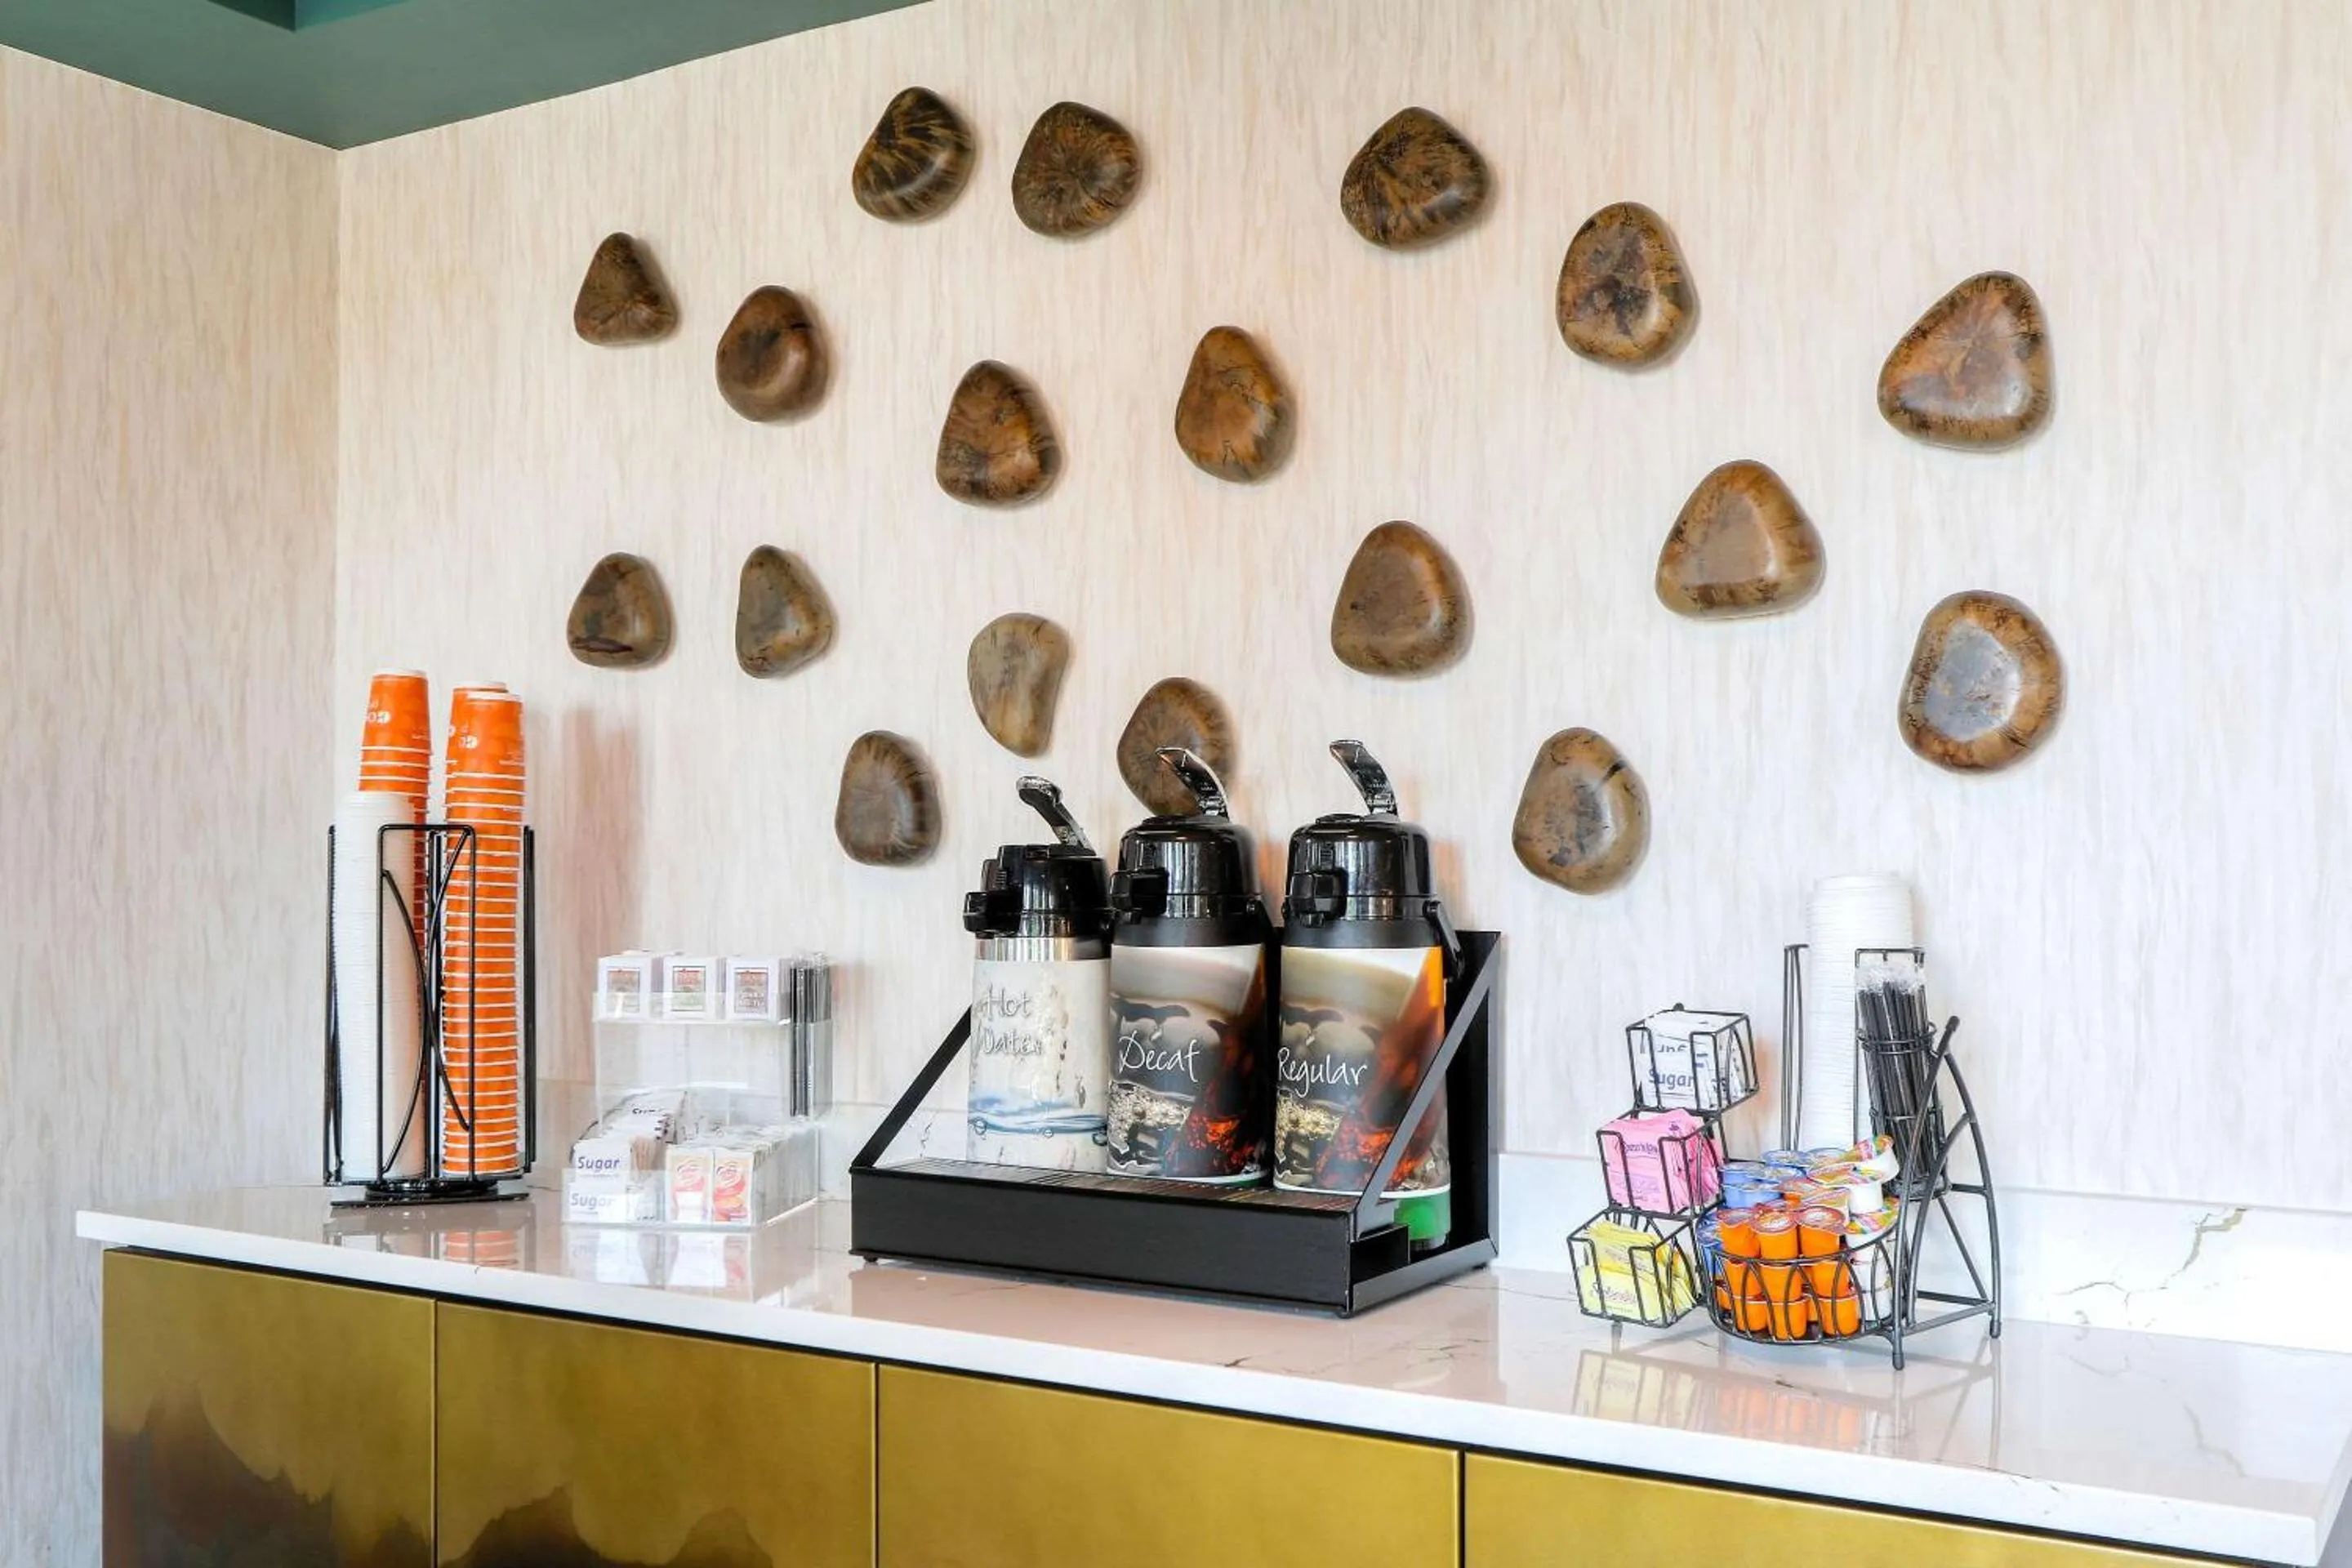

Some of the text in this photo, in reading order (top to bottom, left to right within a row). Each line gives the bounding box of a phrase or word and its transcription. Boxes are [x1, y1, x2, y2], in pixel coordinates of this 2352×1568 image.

[985, 982, 1031, 1021] Hot
[1119, 1029, 1200, 1083] Decaf
[1277, 1046, 1368, 1098] Regular
[577, 1156, 621, 1173] Sugar
[571, 1192, 615, 1210] Sugar
